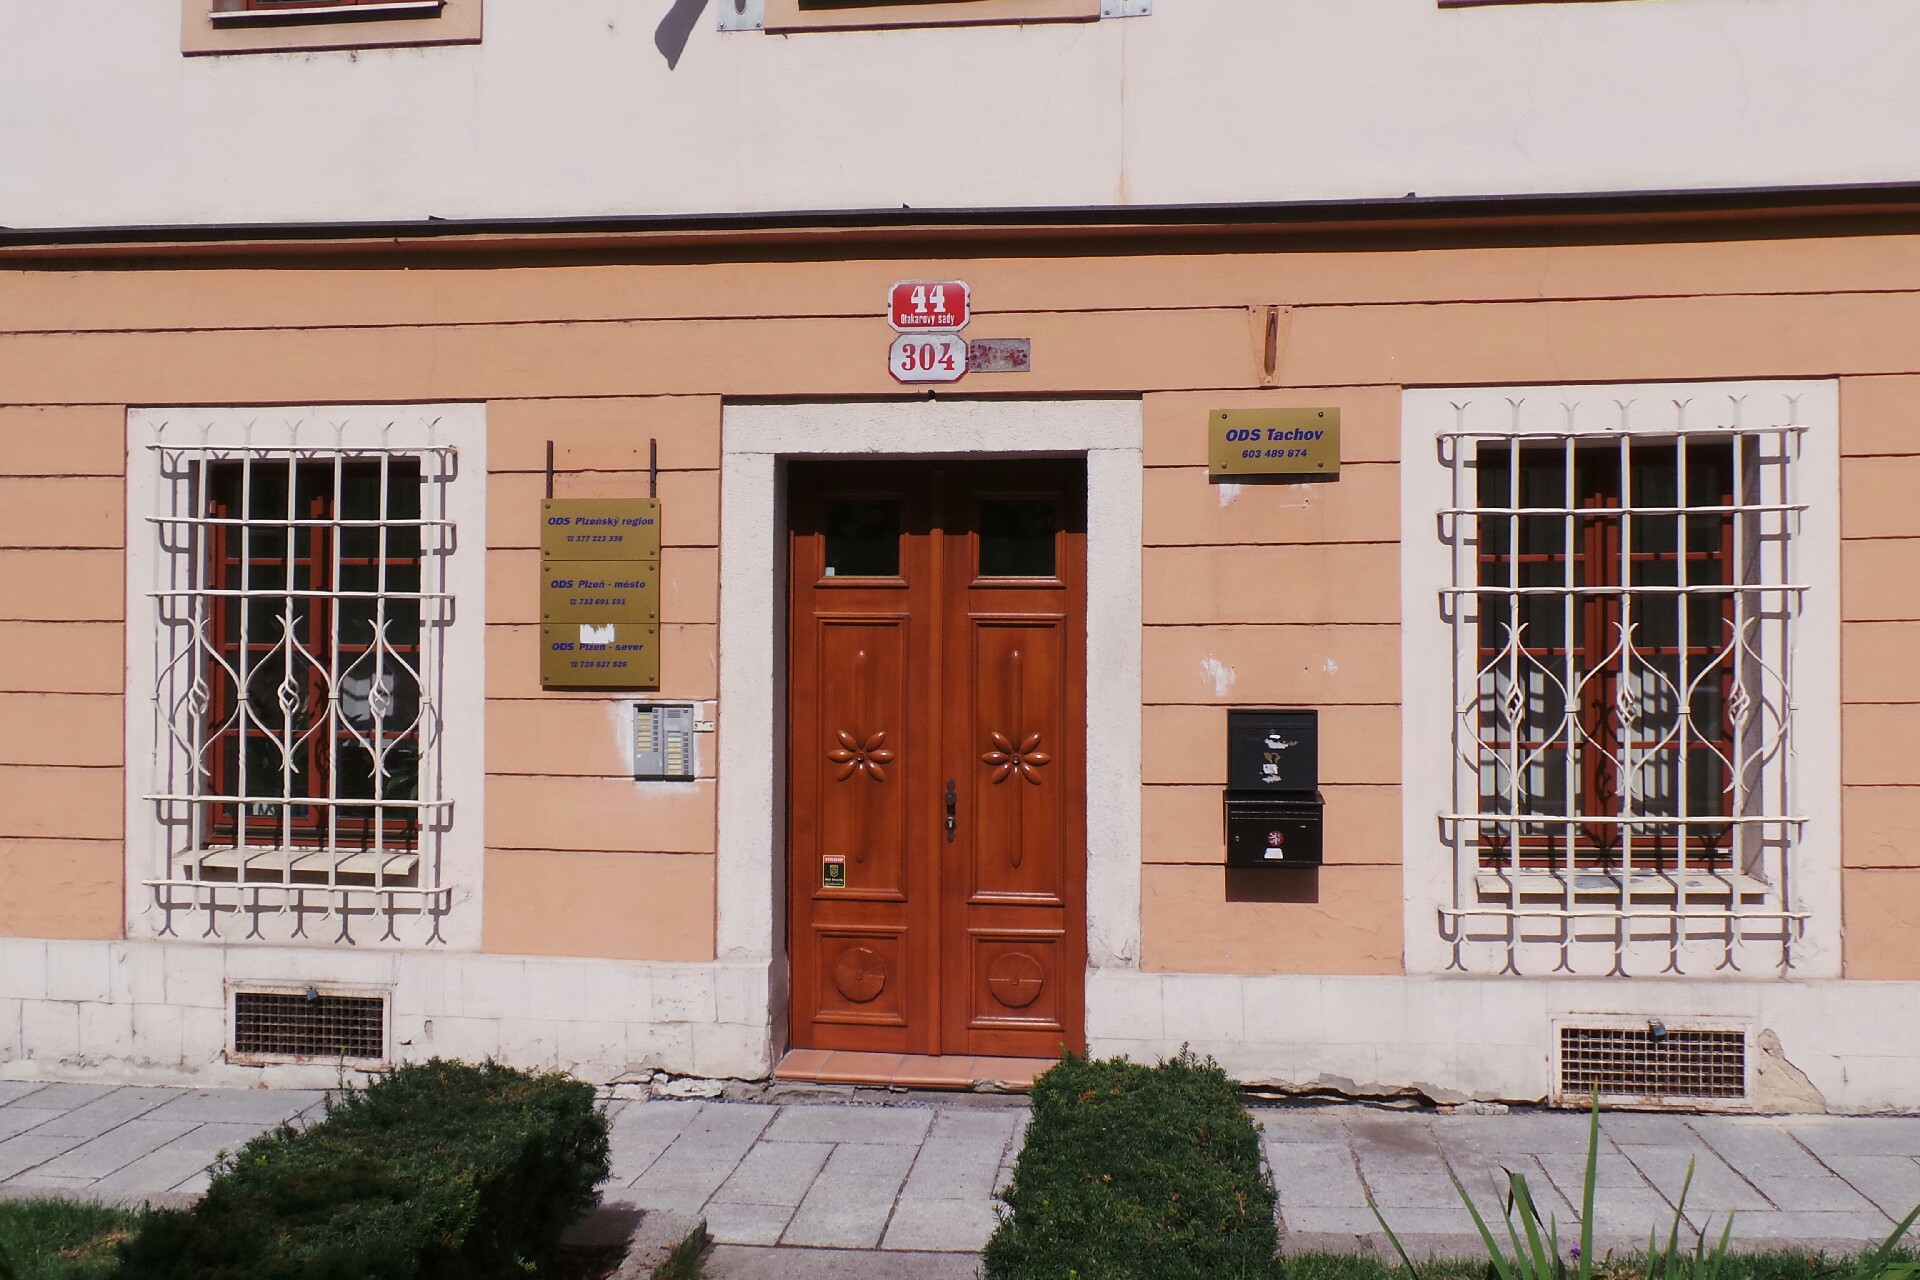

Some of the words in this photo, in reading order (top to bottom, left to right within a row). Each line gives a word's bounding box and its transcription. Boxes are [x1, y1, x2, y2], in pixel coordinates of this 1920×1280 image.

[910, 284, 946, 313] 44
[900, 313, 935, 325] Otakarovy
[938, 313, 955, 325] sady
[901, 343, 955, 371] 304
[1226, 429, 1261, 441] ODS
[1267, 428, 1324, 441] Tachov
[1242, 450, 1261, 458] 603
[1265, 449, 1284, 458] 489
[1287, 449, 1308, 458] 874
[547, 517, 571, 526] ODS
[622, 517, 654, 527] region
[551, 580, 573, 589] ODS
[578, 579, 605, 589] Plzeň
[614, 580, 646, 589] město
[552, 642, 574, 651] ODS
[615, 643, 644, 651] sever
